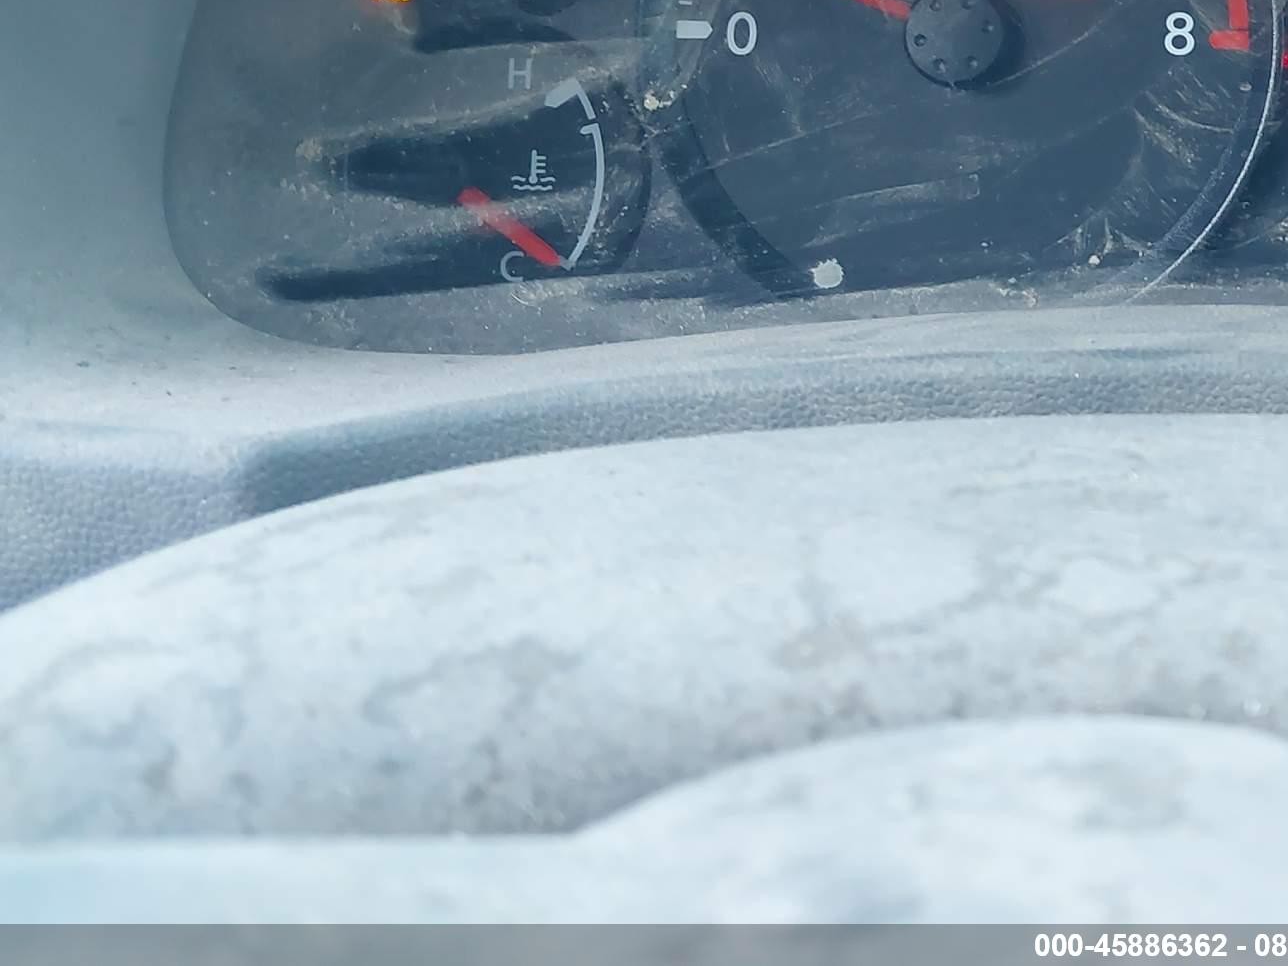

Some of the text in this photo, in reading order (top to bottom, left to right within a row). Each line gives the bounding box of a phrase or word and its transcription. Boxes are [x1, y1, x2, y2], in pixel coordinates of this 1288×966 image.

[727, 11, 757, 55] 0
[1164, 12, 1195, 55] 8
[508, 58, 532, 89] H
[501, 251, 524, 282] C
